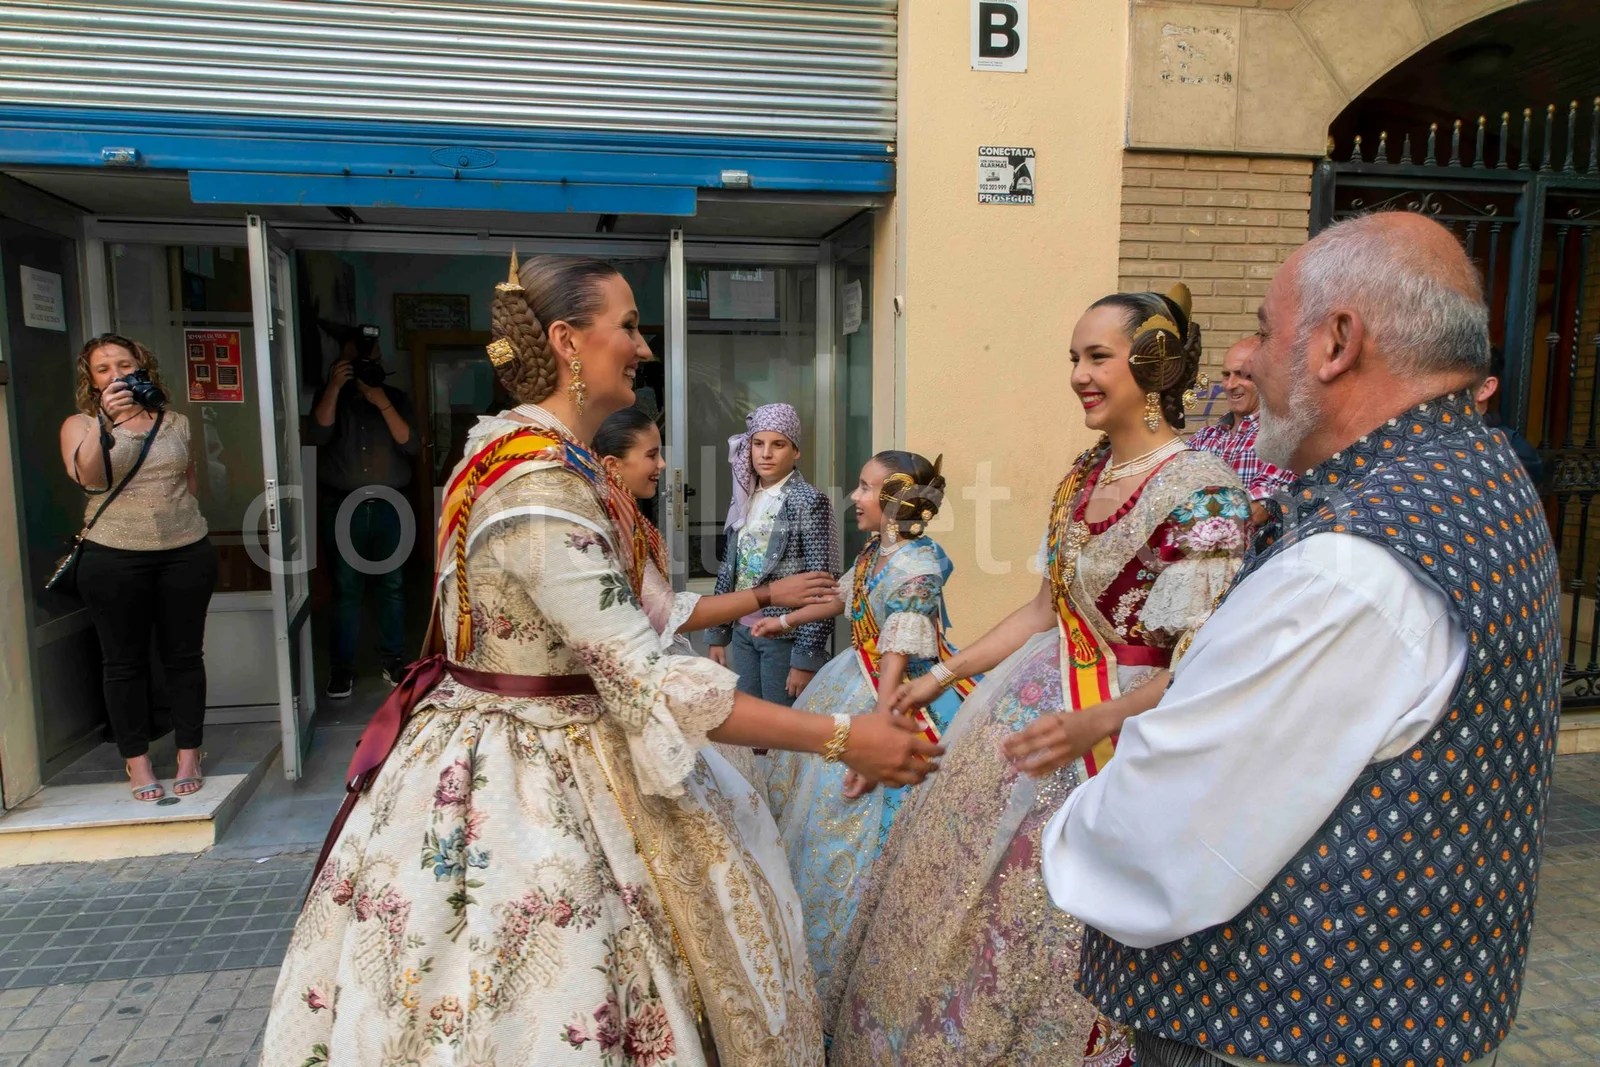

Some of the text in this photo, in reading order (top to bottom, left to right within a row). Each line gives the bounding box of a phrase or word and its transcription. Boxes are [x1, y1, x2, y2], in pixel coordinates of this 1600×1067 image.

[979, 2, 1020, 58] B
[980, 147, 1034, 156] CONECTADA
[979, 194, 1033, 203] PROSEGUR
